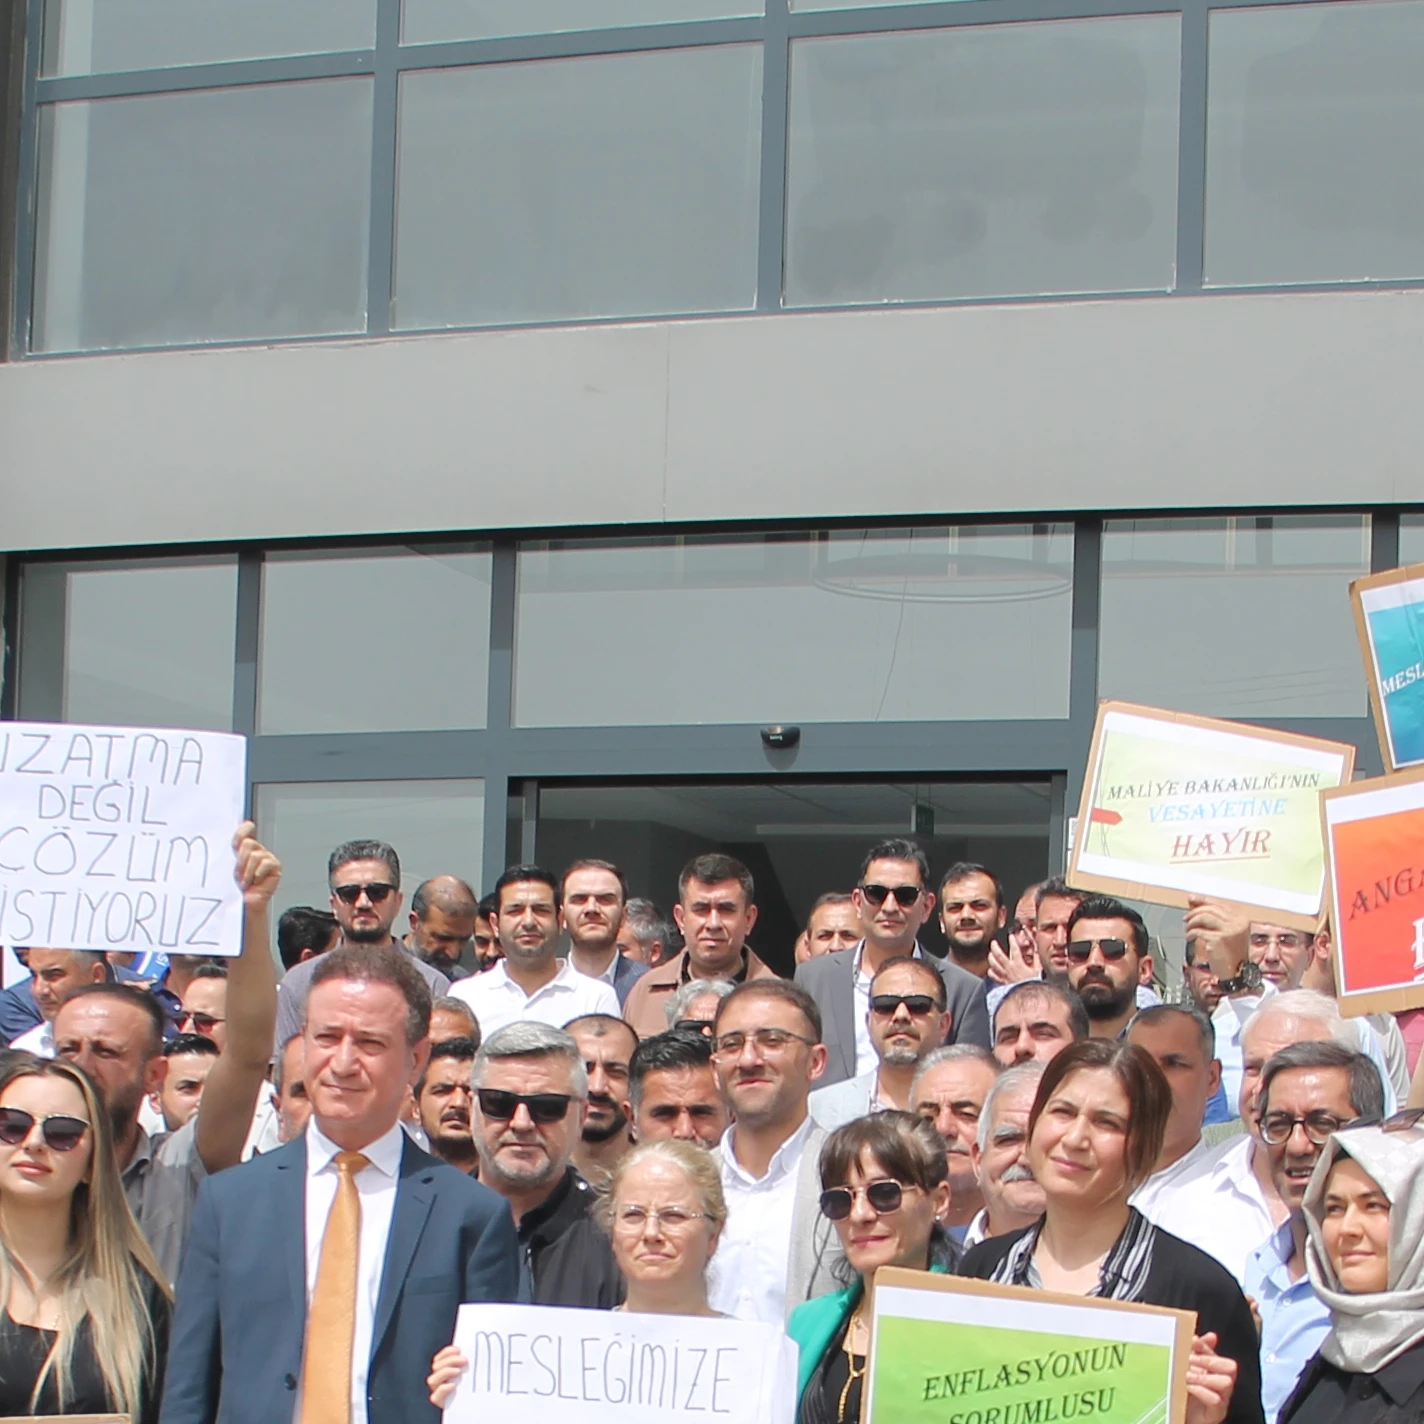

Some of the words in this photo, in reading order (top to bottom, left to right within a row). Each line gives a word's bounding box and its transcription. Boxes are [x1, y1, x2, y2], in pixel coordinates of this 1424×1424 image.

[1107, 779, 1179, 801] MALİYE
[1170, 827, 1272, 858] HAYIR
[923, 1343, 1128, 1402] ENFLASYONUN
